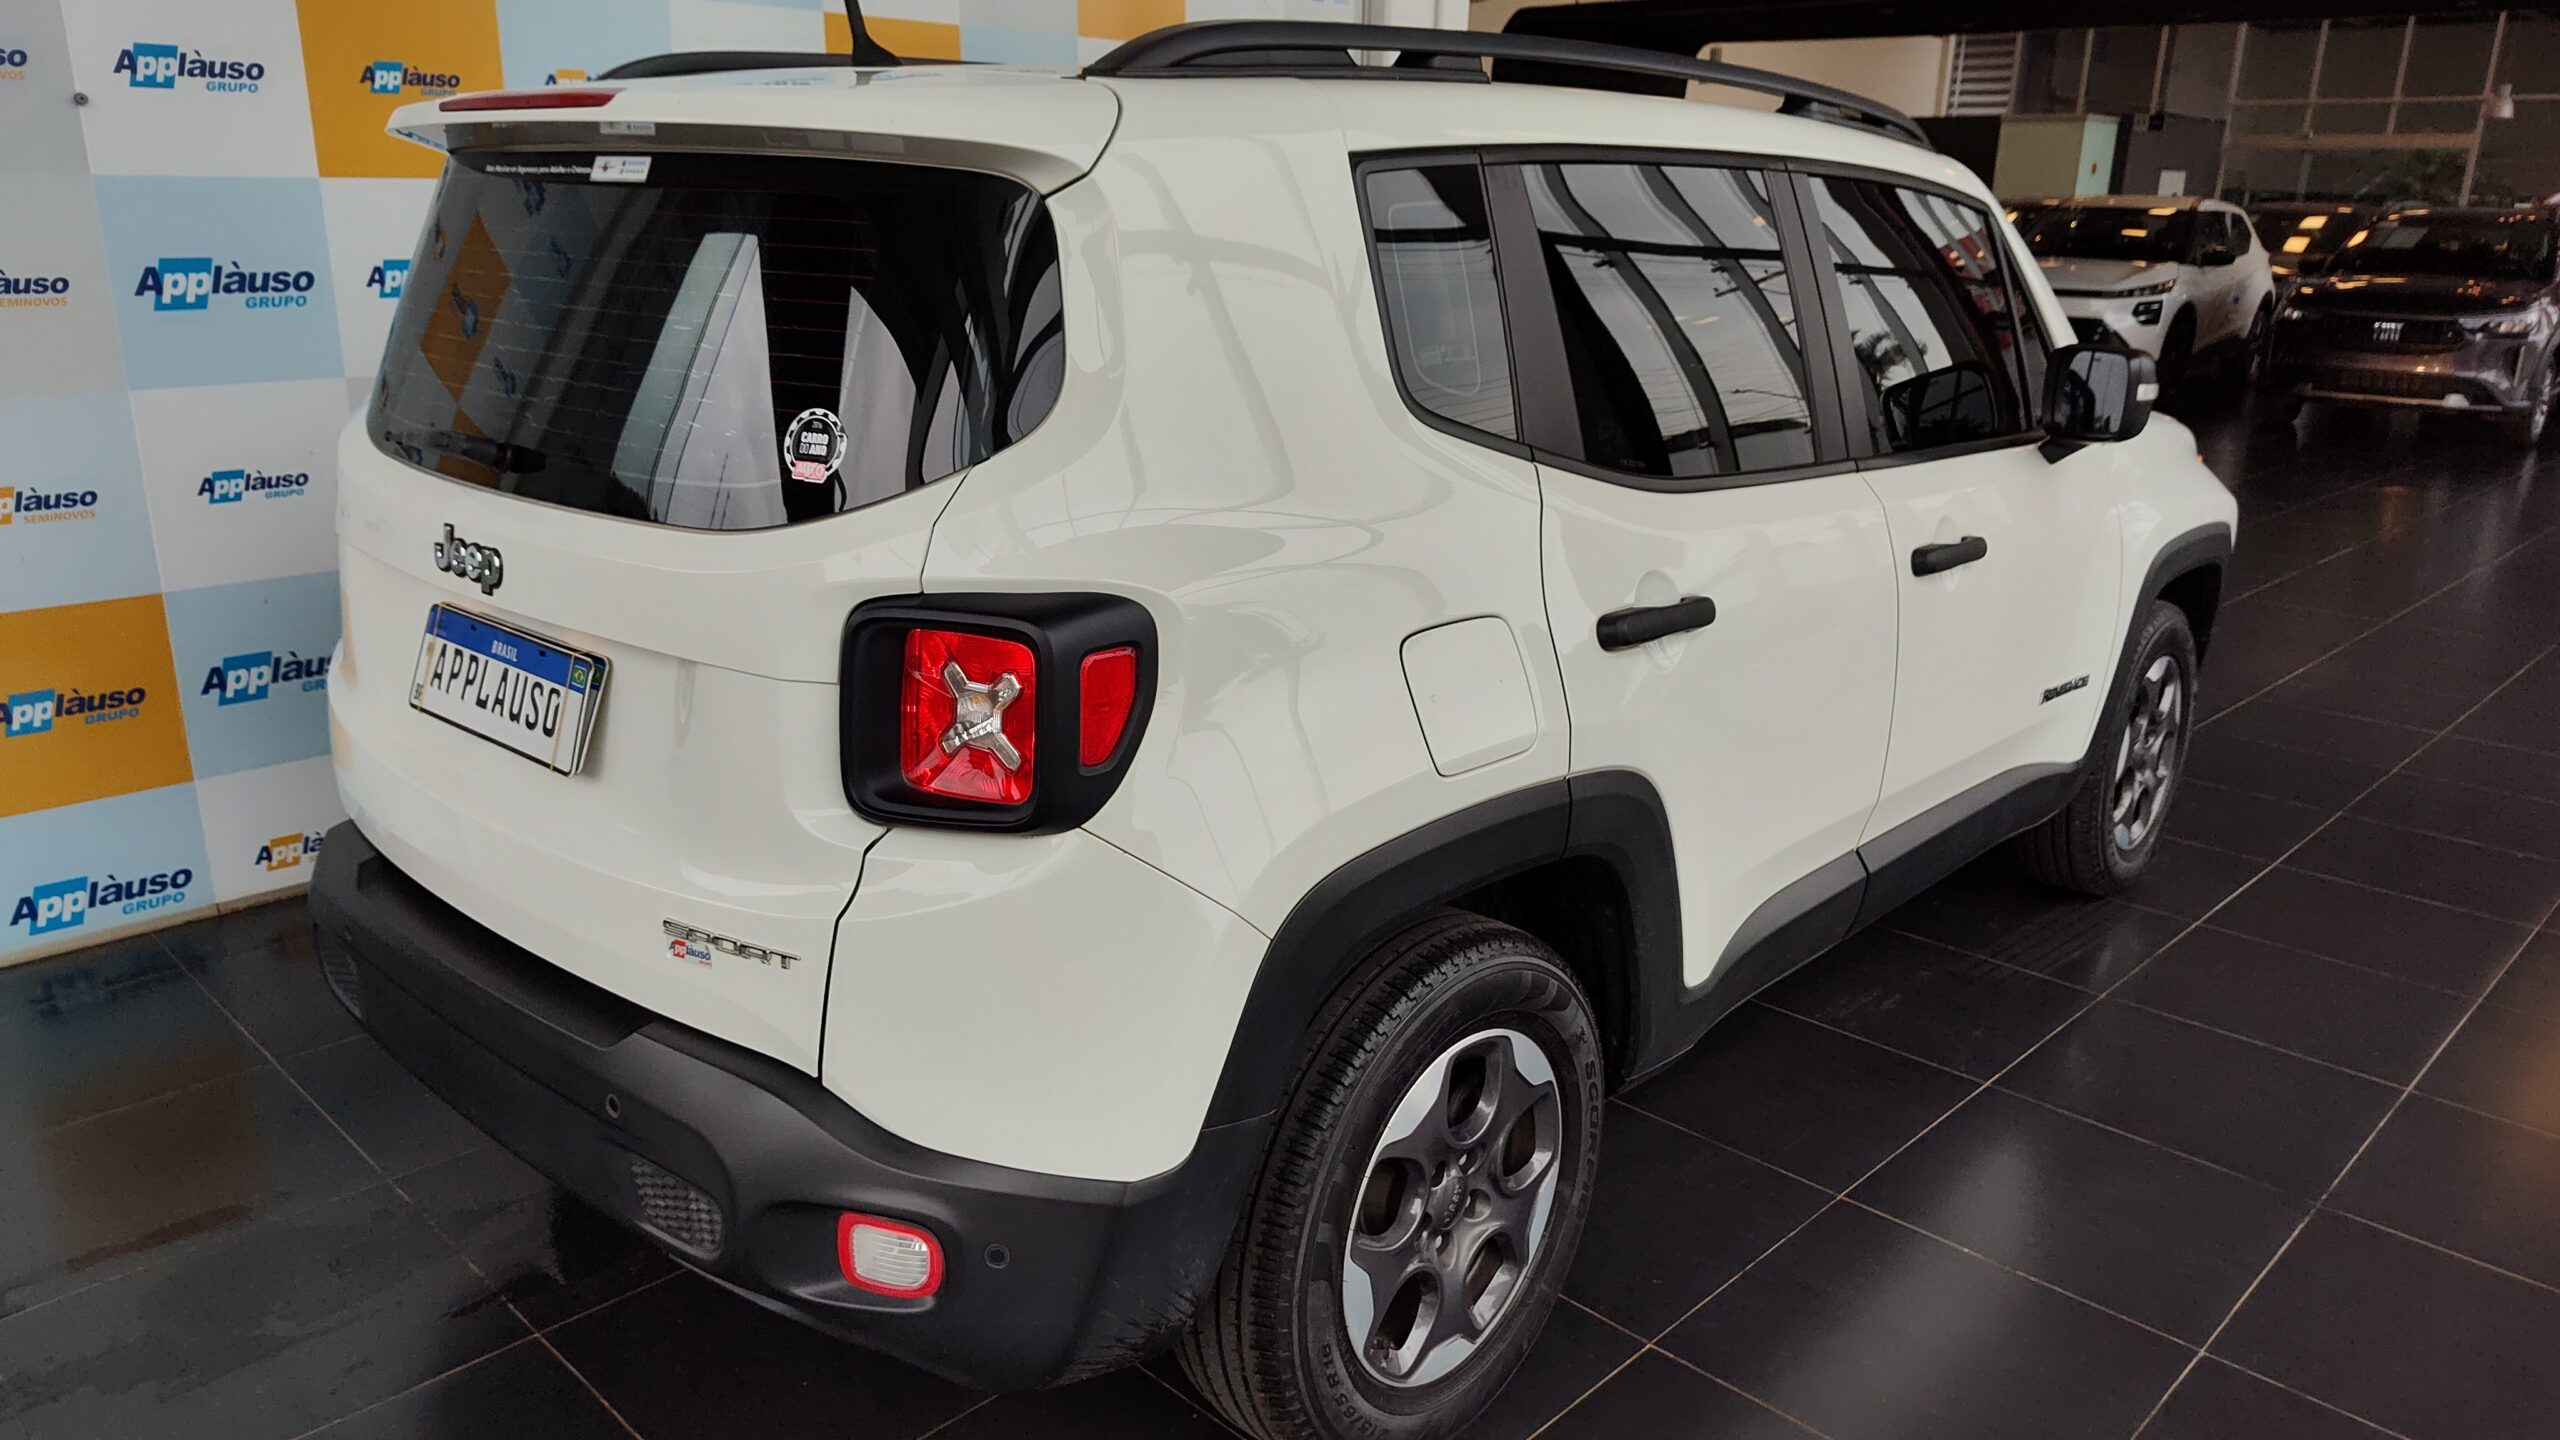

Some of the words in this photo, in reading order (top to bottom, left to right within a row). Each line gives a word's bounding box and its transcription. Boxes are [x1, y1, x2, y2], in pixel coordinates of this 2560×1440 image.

[113, 48, 265, 85] Applàuso
[360, 65, 461, 91] Applàuso
[206, 80, 259, 94] GRUPO
[134, 261, 315, 304] Applàuso
[245, 294, 308, 309] GRUPO
[197, 471, 309, 499] Applàuso
[264, 488, 305, 500] GRUPO
[23, 509, 96, 525] SEMINOVOS
[434, 522, 504, 597] Jeep
[491, 639, 518, 663] BRASIL
[201, 650, 332, 699] Applàu
[429, 643, 562, 738] APPLAUSO
[85, 707, 140, 725] GRUPO
[10, 868, 193, 928] Applàuso
[122, 891, 186, 916] GRUPO
[662, 917, 801, 970] SPORT
